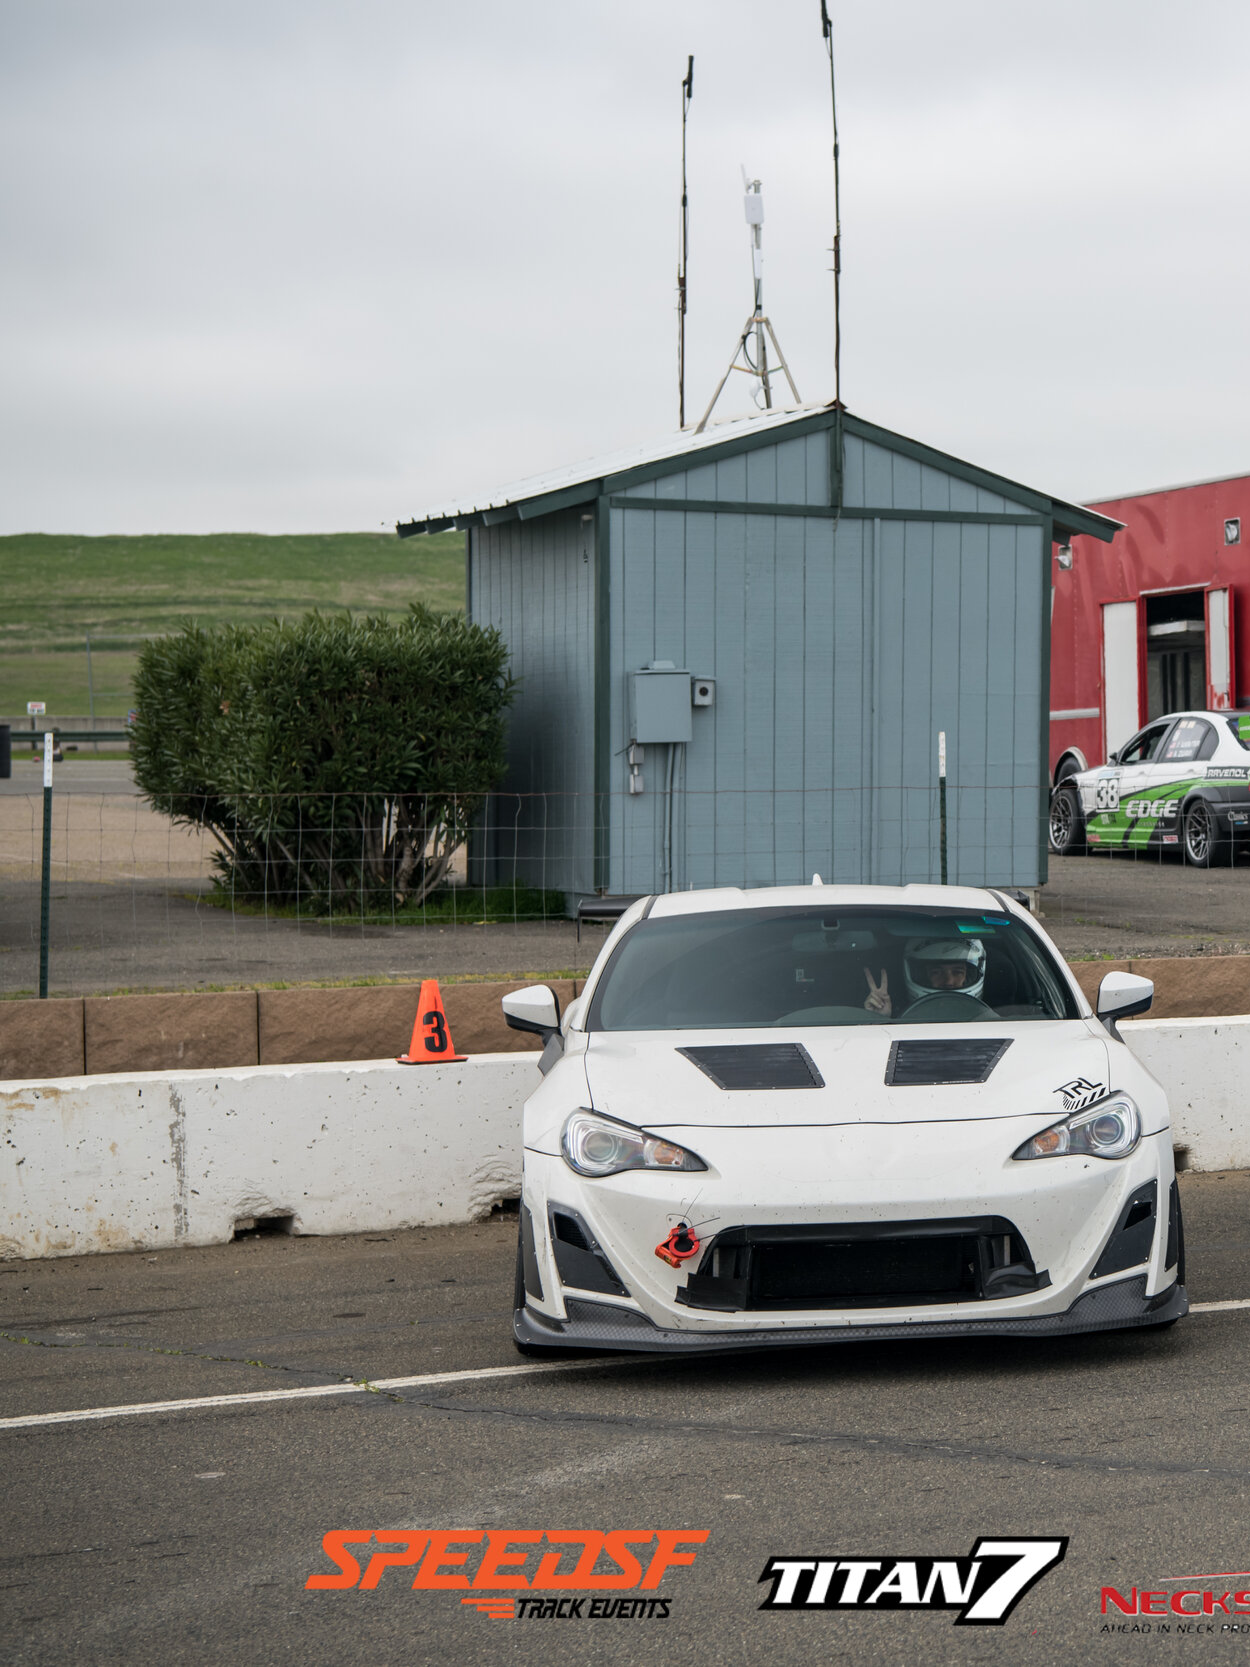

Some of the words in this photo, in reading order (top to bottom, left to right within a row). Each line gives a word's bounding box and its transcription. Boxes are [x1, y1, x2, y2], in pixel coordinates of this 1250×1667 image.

[1208, 768, 1246, 778] RAVENOL
[1098, 779, 1119, 809] 38
[1126, 799, 1179, 818] EDGE
[423, 1010, 448, 1053] 3
[1052, 1077, 1103, 1099] TRL
